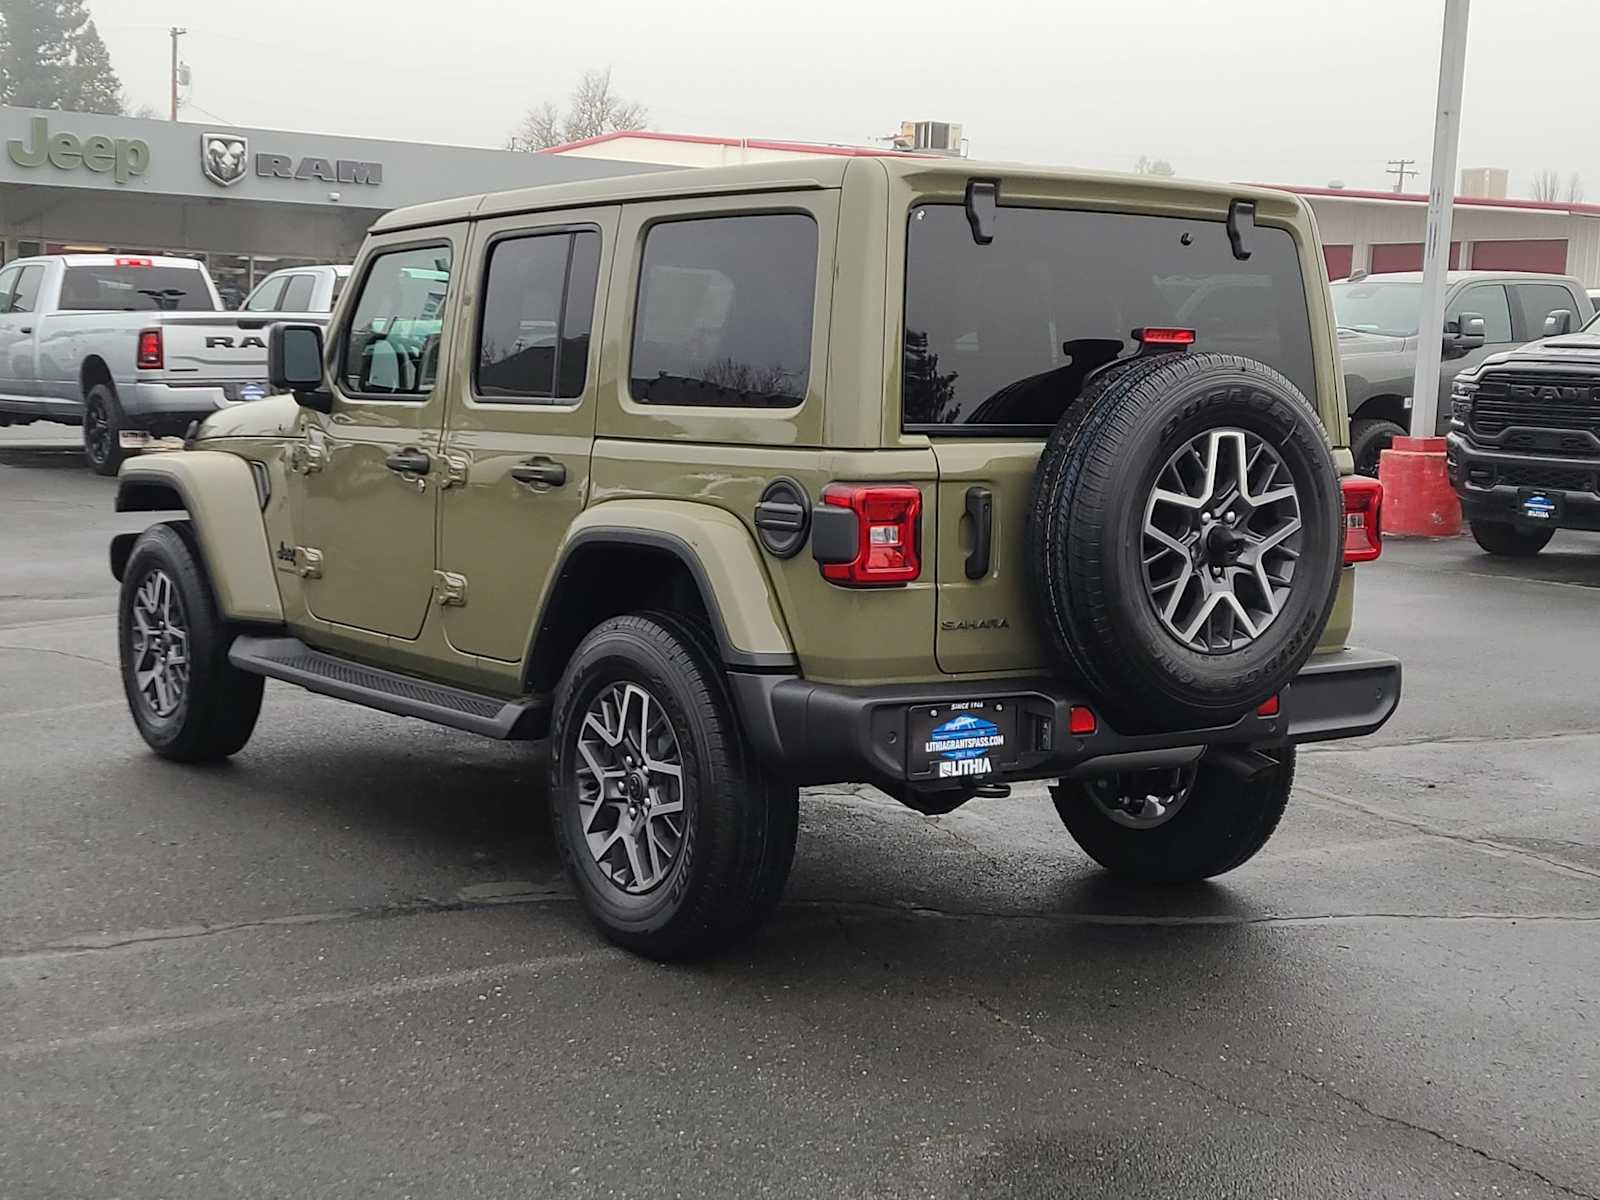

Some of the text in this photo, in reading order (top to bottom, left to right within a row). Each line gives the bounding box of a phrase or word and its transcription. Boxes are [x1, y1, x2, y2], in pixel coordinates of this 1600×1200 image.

[8, 117, 150, 184] Jeep
[256, 152, 383, 185] RAM
[206, 337, 268, 349] RA
[941, 617, 1009, 631] SAHARA
[951, 702, 969, 711] SINCE
[925, 735, 1004, 752] LITHIAGRANTSPASS.COM
[951, 757, 992, 776] LITHIA
